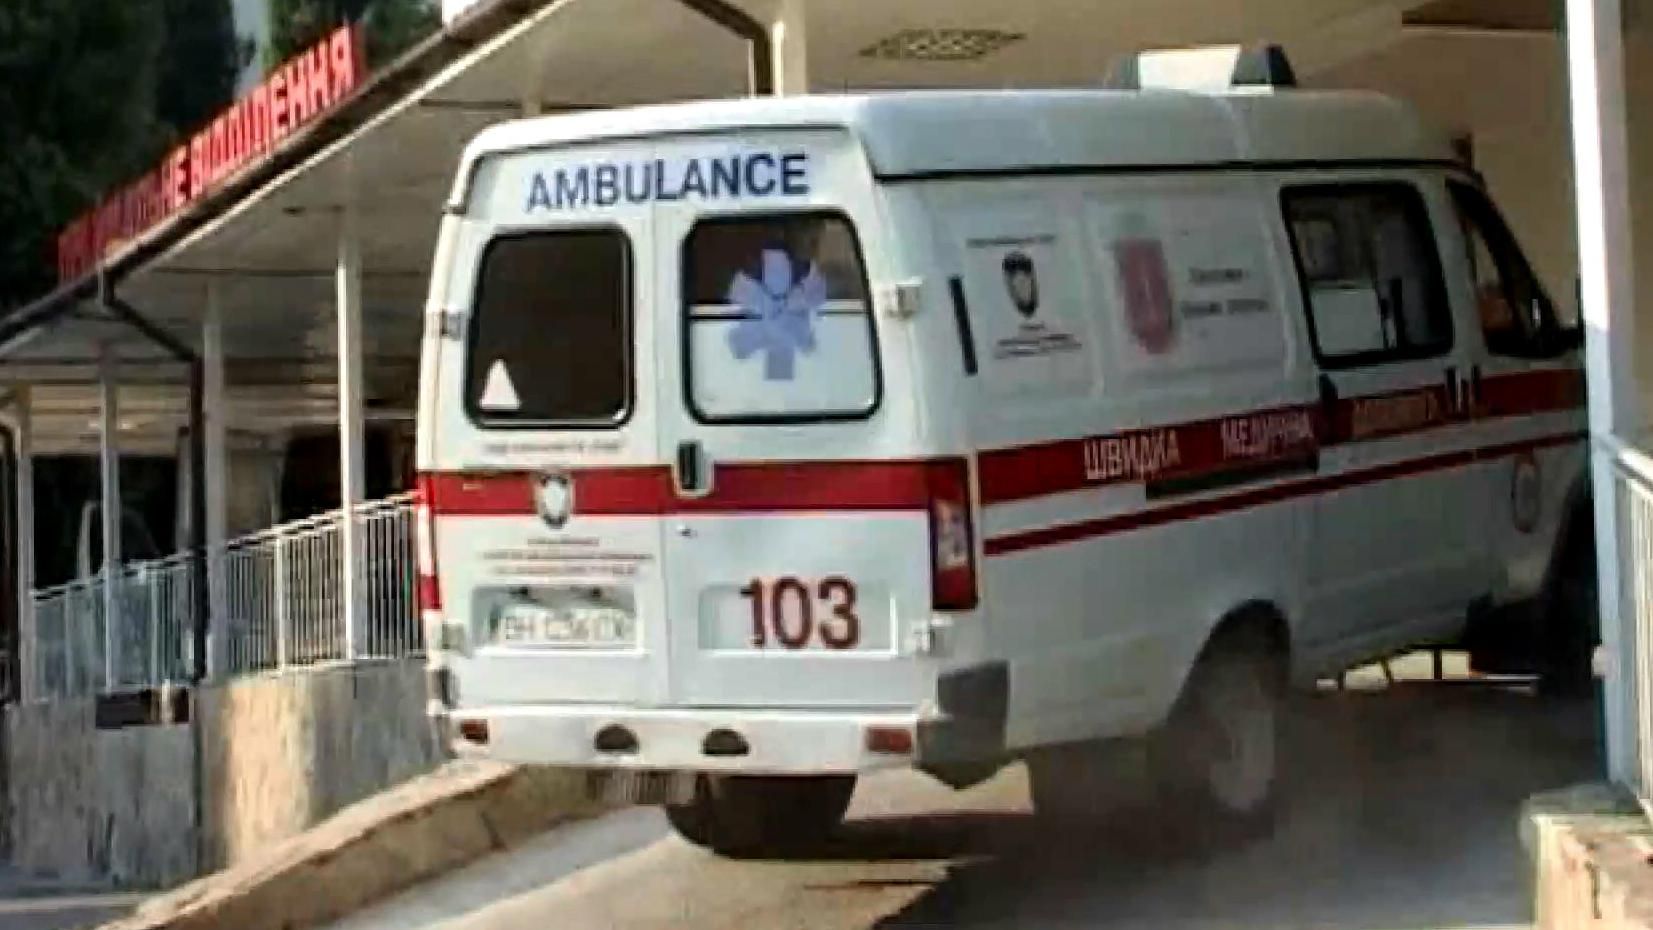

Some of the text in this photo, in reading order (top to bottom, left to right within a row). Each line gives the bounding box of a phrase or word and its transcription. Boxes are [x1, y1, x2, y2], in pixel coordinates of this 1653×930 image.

[526, 152, 810, 213] AMBULANCE
[1084, 429, 1181, 481] ШВИДКА
[740, 576, 860, 649] 103
